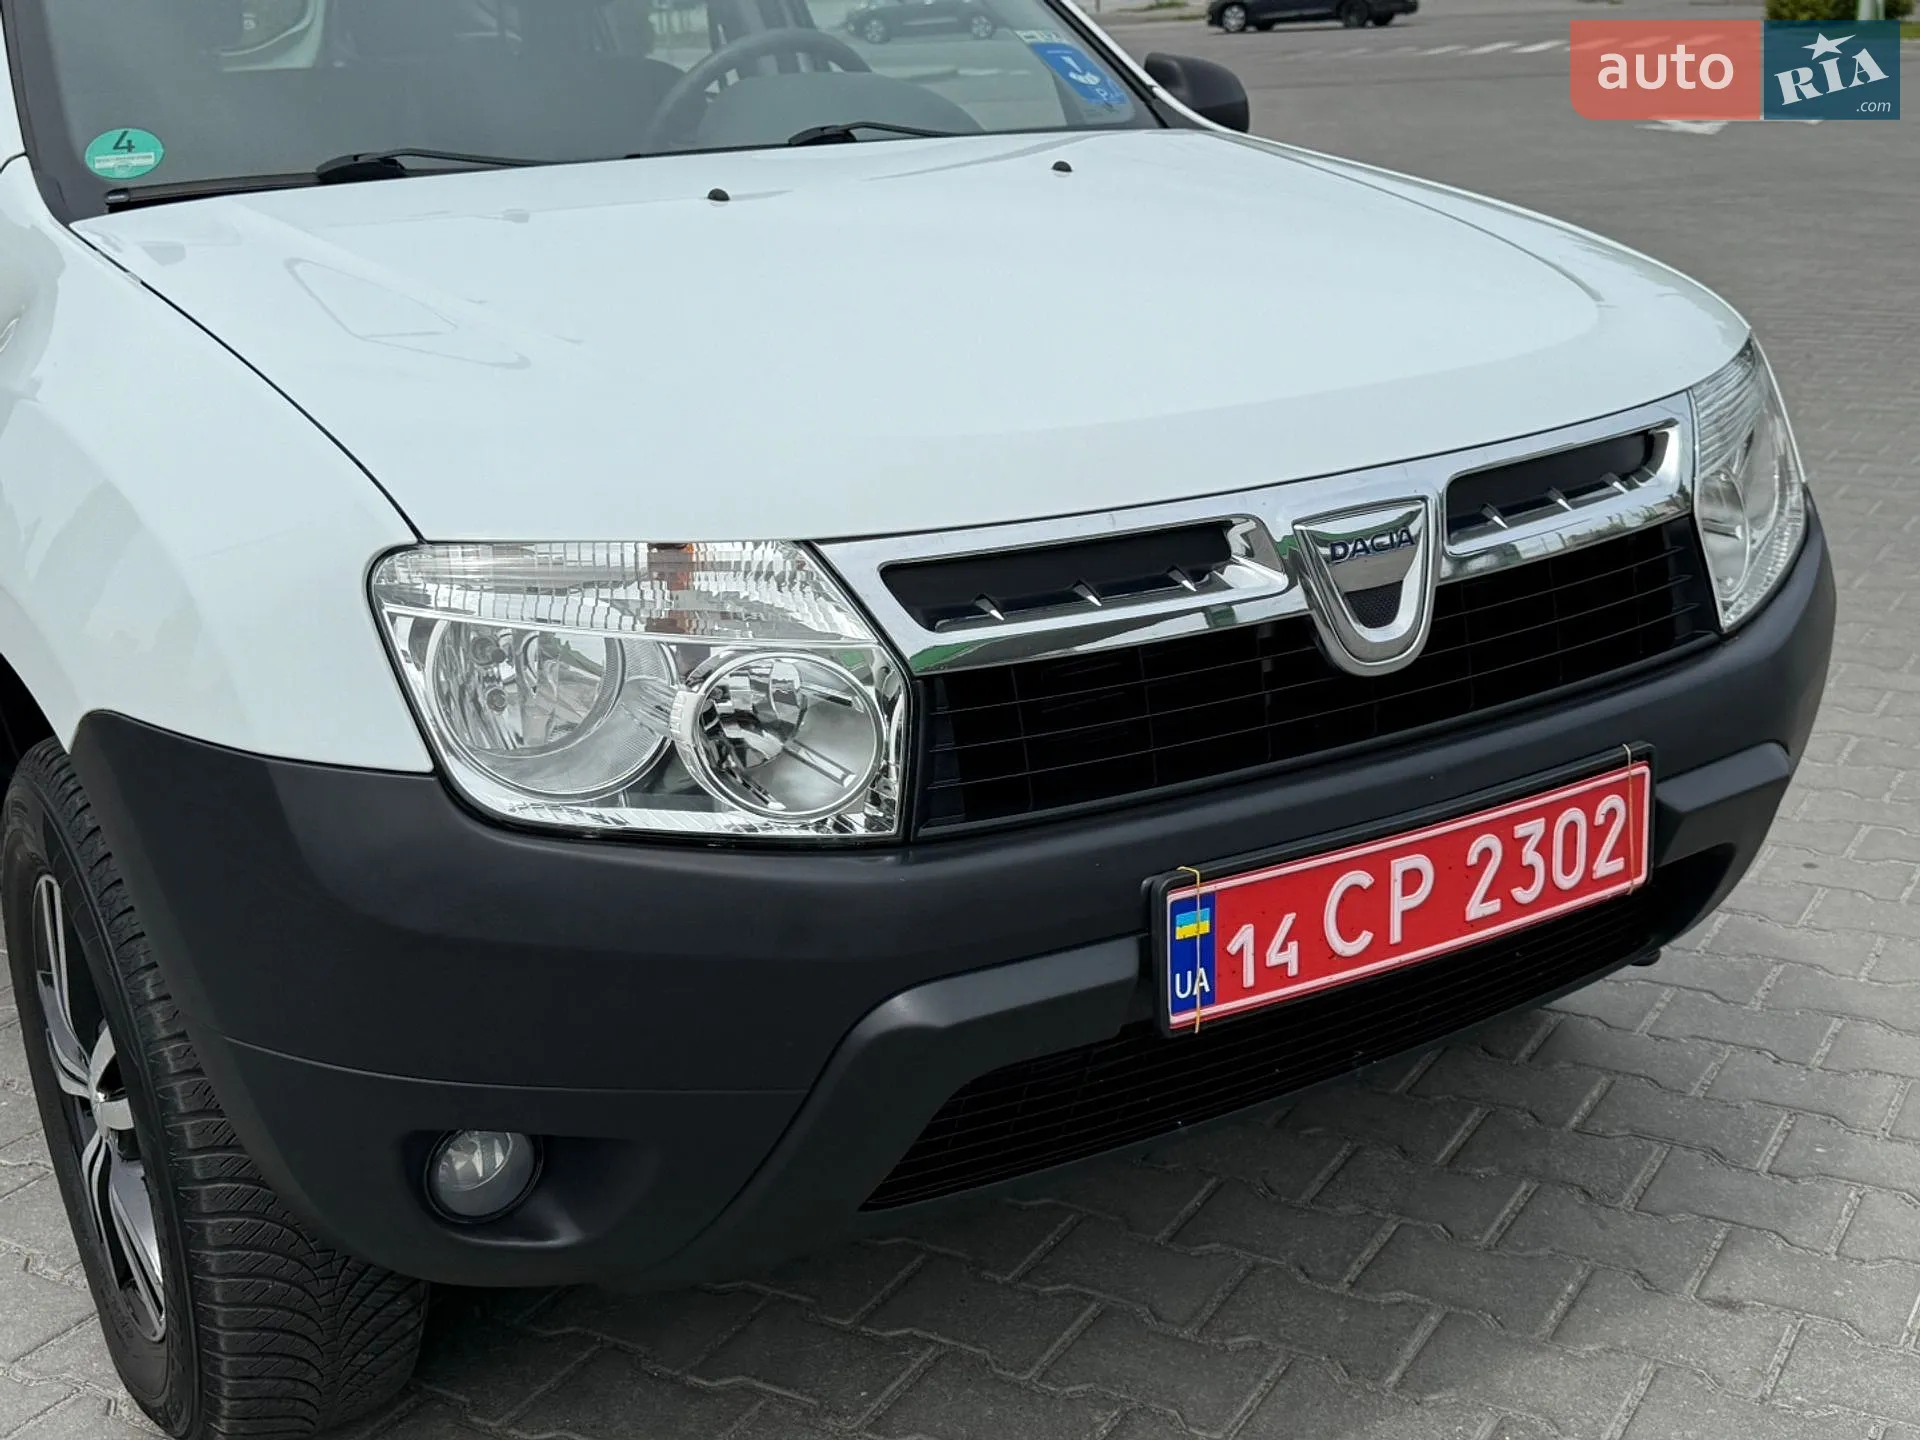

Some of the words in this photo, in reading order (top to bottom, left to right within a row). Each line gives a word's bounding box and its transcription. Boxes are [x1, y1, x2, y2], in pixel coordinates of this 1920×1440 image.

[112, 130, 135, 153] 4
[1329, 526, 1415, 564] DACIA
[1226, 912, 1299, 988] 14
[1323, 853, 1435, 958] CP
[1464, 794, 1627, 921] 2302
[1174, 967, 1211, 999] UA
